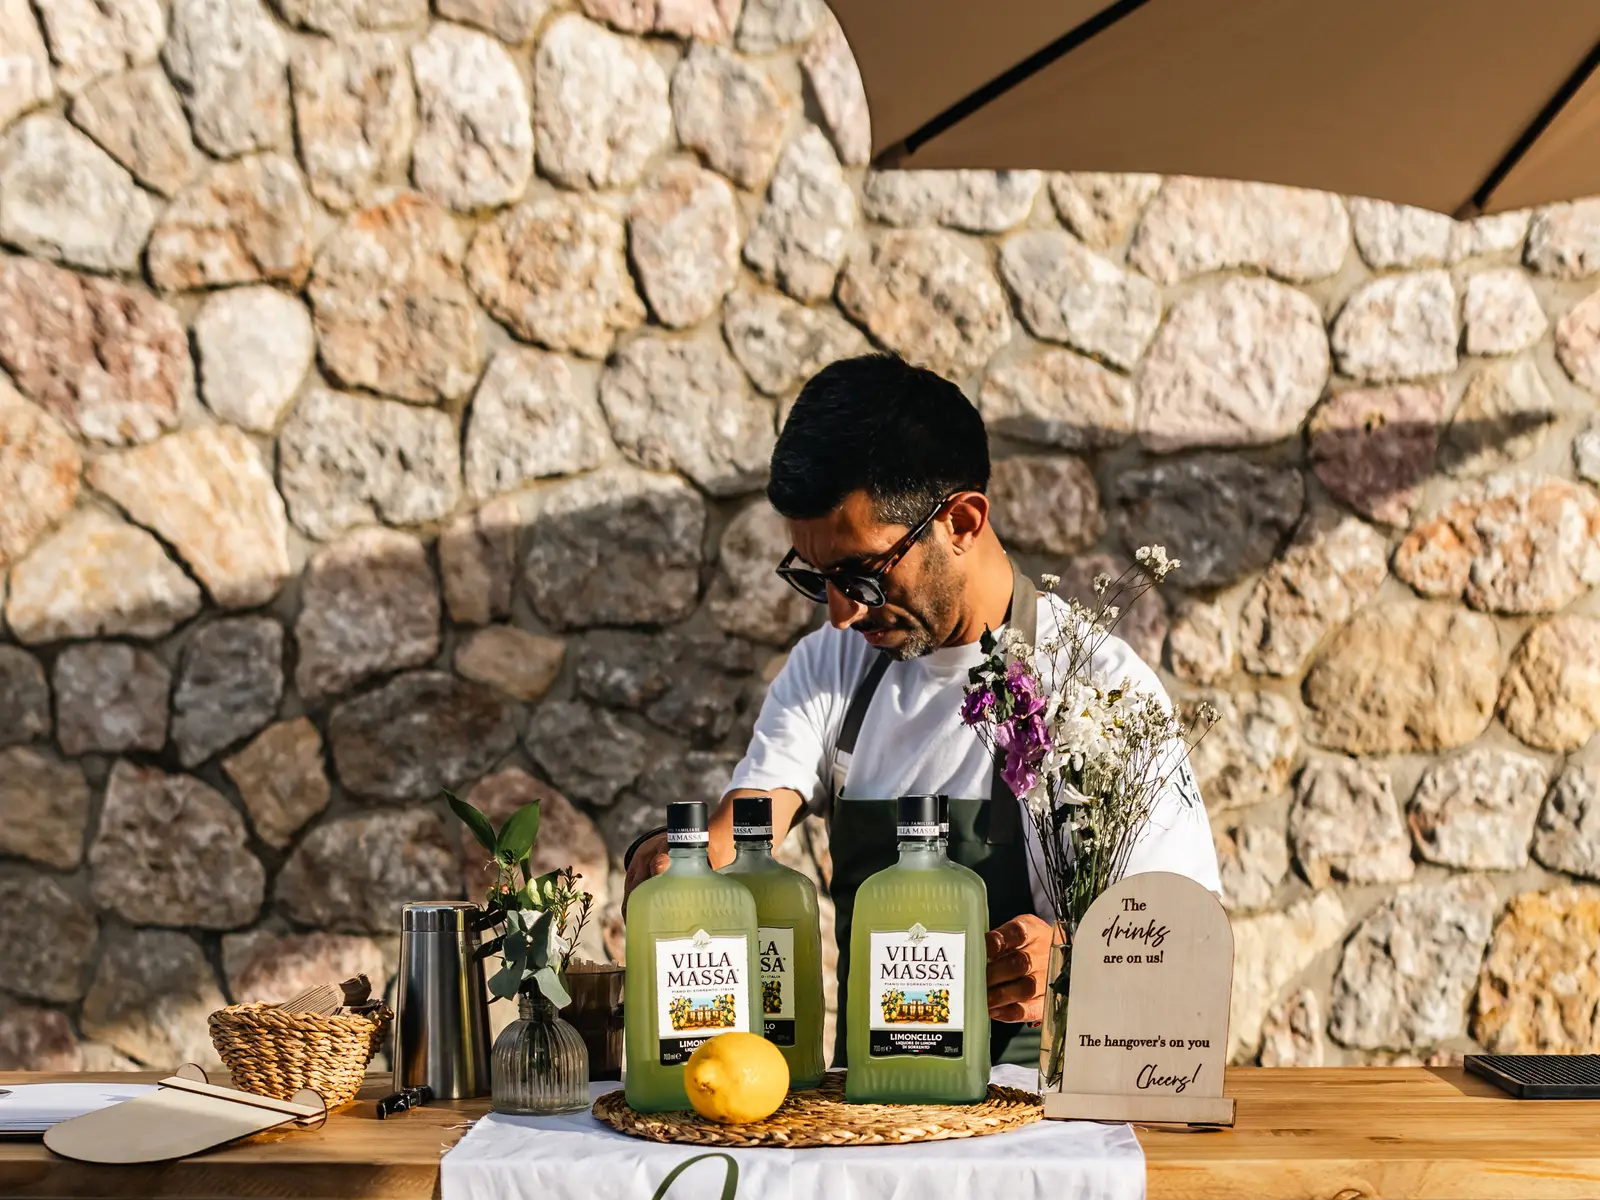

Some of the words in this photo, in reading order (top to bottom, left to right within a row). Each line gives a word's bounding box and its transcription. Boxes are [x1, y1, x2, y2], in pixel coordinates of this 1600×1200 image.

[1121, 898, 1147, 911] The
[1101, 914, 1171, 948] drinks
[671, 952, 732, 969] VILLA
[885, 945, 948, 962] VILLA
[1103, 954, 1123, 964] are
[1126, 954, 1142, 964] on
[1145, 950, 1164, 964] us!
[667, 969, 739, 988] MASSA
[880, 963, 954, 980] MASSA
[679, 1039, 706, 1048] LIMON
[890, 1033, 942, 1041] LIMONCELLO
[1078, 1034, 1101, 1047] The
[1104, 1034, 1166, 1051] hangover's
[1169, 1039, 1184, 1048] on
[1187, 1039, 1211, 1051] you
[1136, 1063, 1203, 1094] Cheers!
